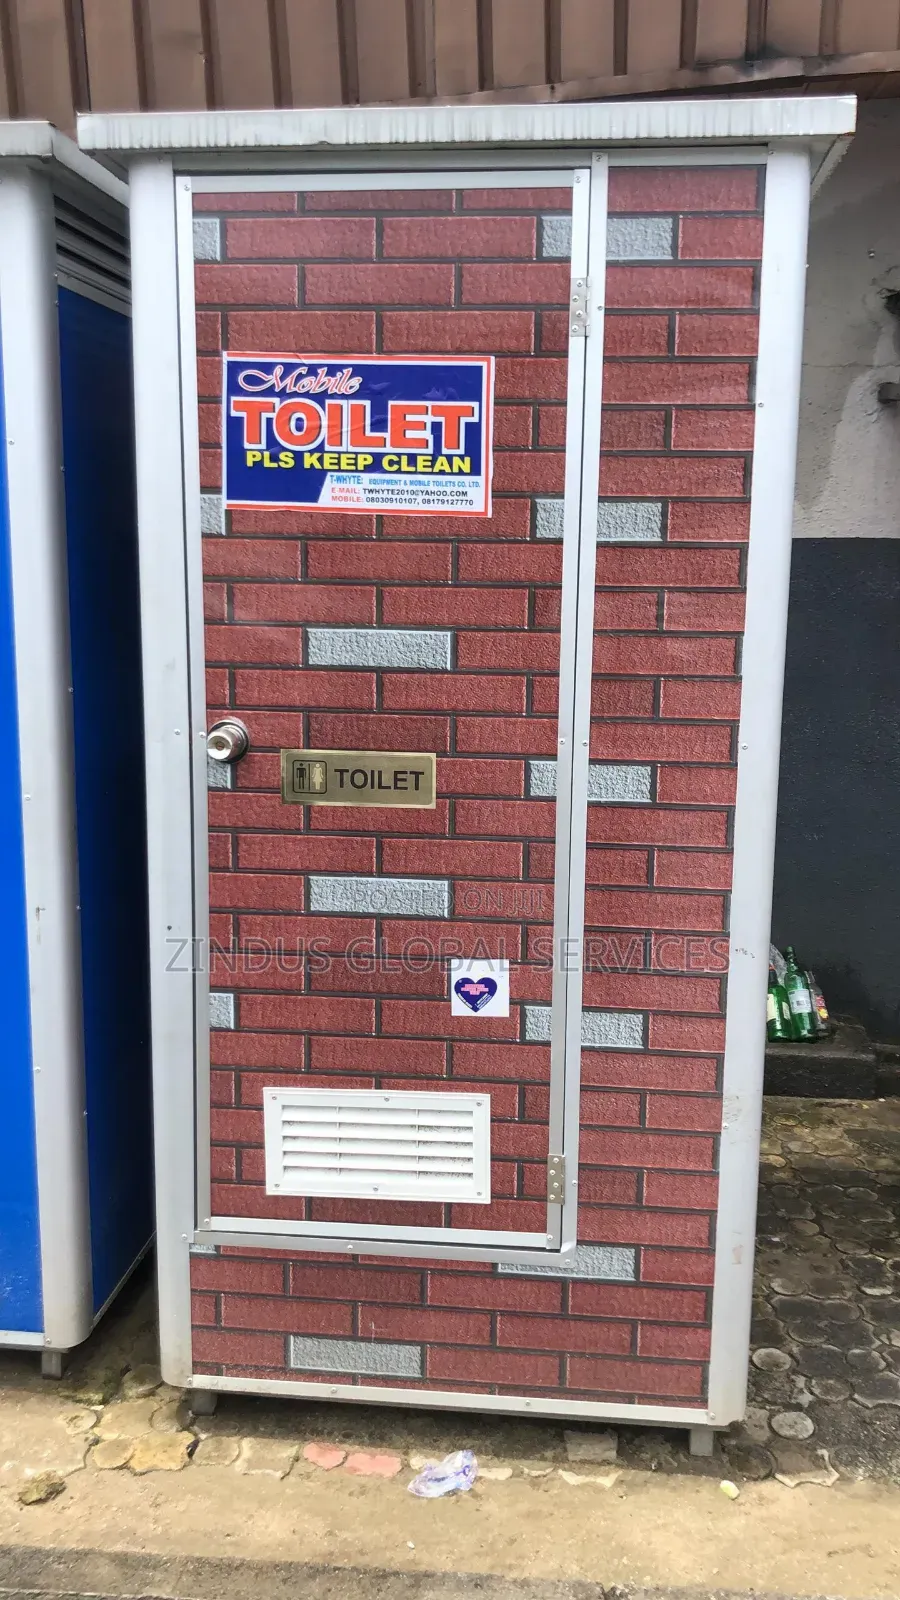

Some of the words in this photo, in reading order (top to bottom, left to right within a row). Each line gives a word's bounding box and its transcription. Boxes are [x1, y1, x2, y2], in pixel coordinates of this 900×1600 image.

[238, 364, 363, 395] Mobile
[231, 396, 480, 455] TOILET
[246, 451, 296, 469] PLS
[303, 452, 374, 471] KEEP
[381, 454, 472, 474] CLEAN
[329, 474, 363, 485] T-WHYTE:
[368, 478, 403, 486] EQUIPMENT
[403, 479, 408, 487] &
[409, 479, 431, 488] MOBILE
[432, 480, 457, 488] TOILETS
[457, 480, 467, 488] CO.
[468, 480, 481, 488] LTD.
[362, 488, 468, 497] TWHYTE2010@YAHOO.COM
[331, 495, 363, 503] MOBILE:
[334, 767, 425, 792] TOILET
